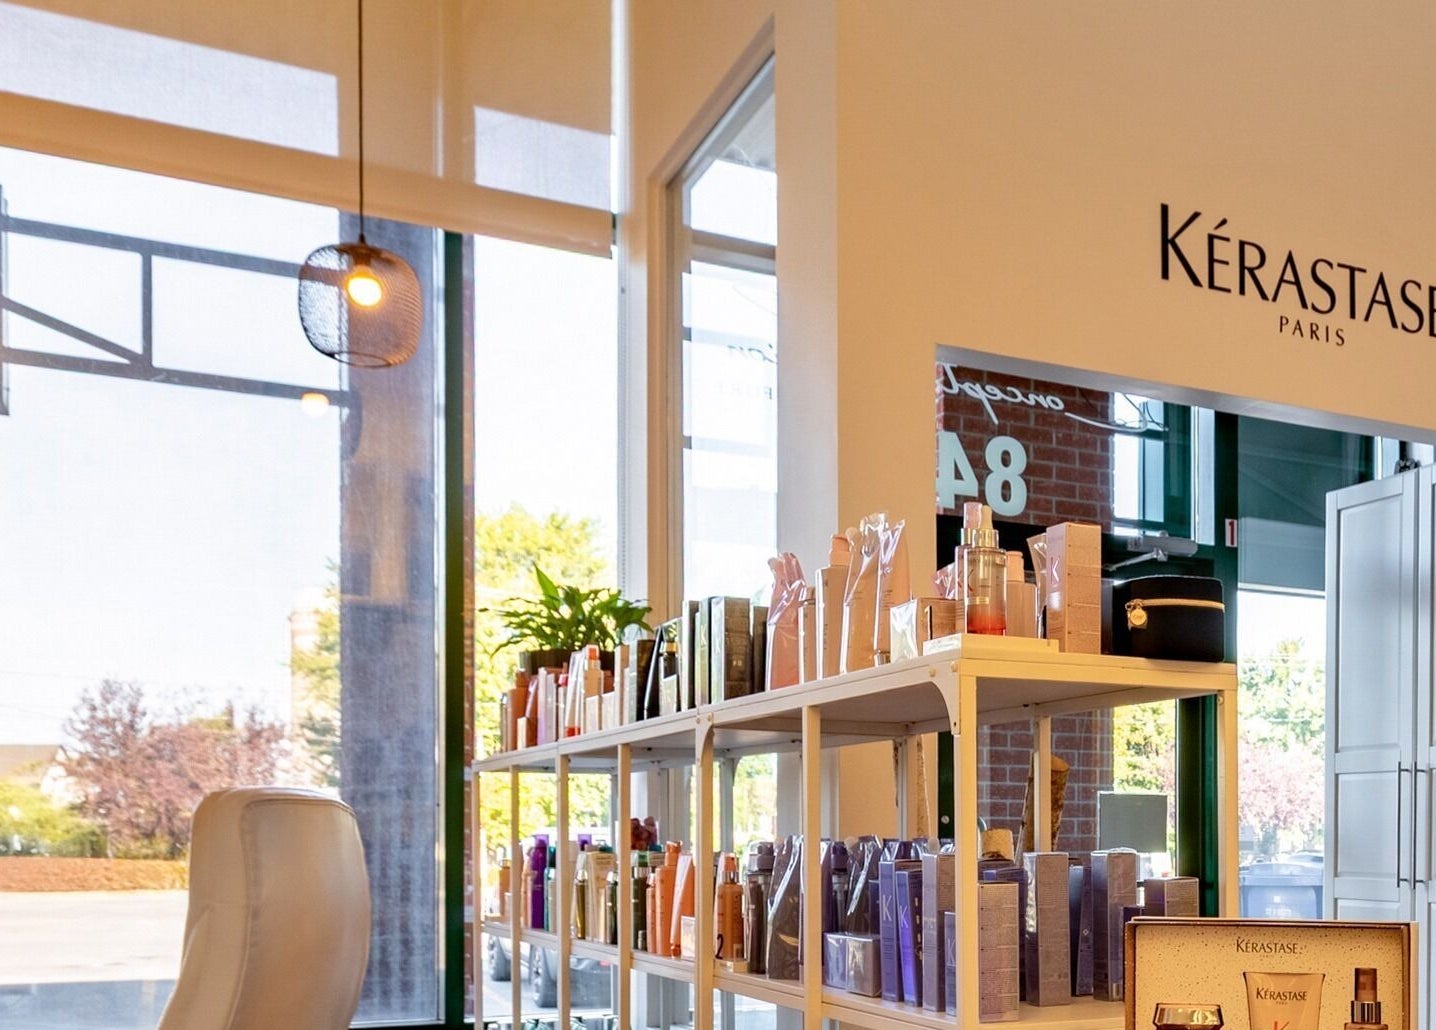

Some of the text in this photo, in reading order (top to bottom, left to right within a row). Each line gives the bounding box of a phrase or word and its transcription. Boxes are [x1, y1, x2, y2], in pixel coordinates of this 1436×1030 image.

[1279, 315, 1345, 346] PARIS
[1236, 937, 1299, 955] KÉRASTASE
[1256, 987, 1308, 1001] KÉRASTASE
